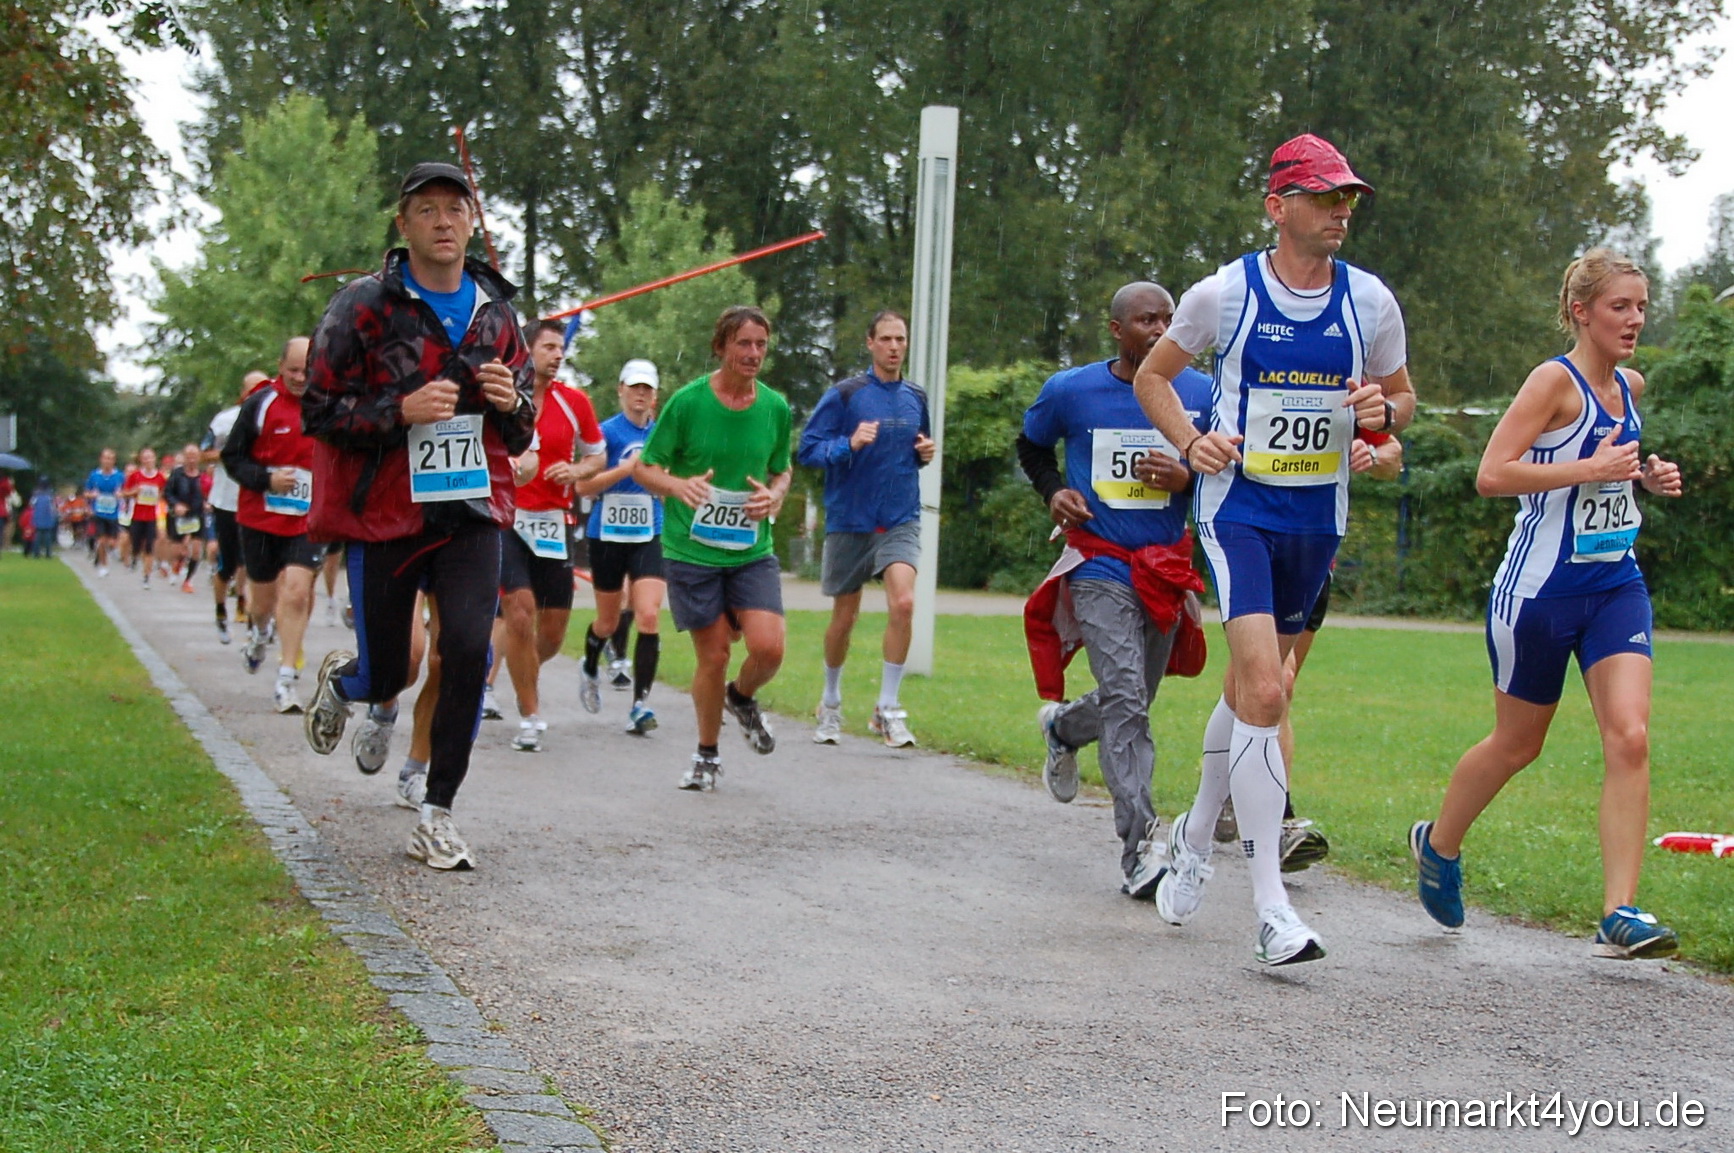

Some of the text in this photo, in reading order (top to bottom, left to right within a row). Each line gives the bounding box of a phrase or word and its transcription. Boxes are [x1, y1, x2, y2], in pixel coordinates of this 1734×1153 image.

[1257, 322, 1294, 337] HEITEC
[1259, 370, 1342, 387] LAC QUELLE
[1268, 416, 1331, 452] 296
[419, 436, 482, 471] 2170
[1272, 458, 1320, 473] Carsten
[445, 475, 468, 488] Toni
[1127, 486, 1145, 498] Jot
[607, 506, 648, 525] 3080
[1582, 494, 1634, 531] 2192
